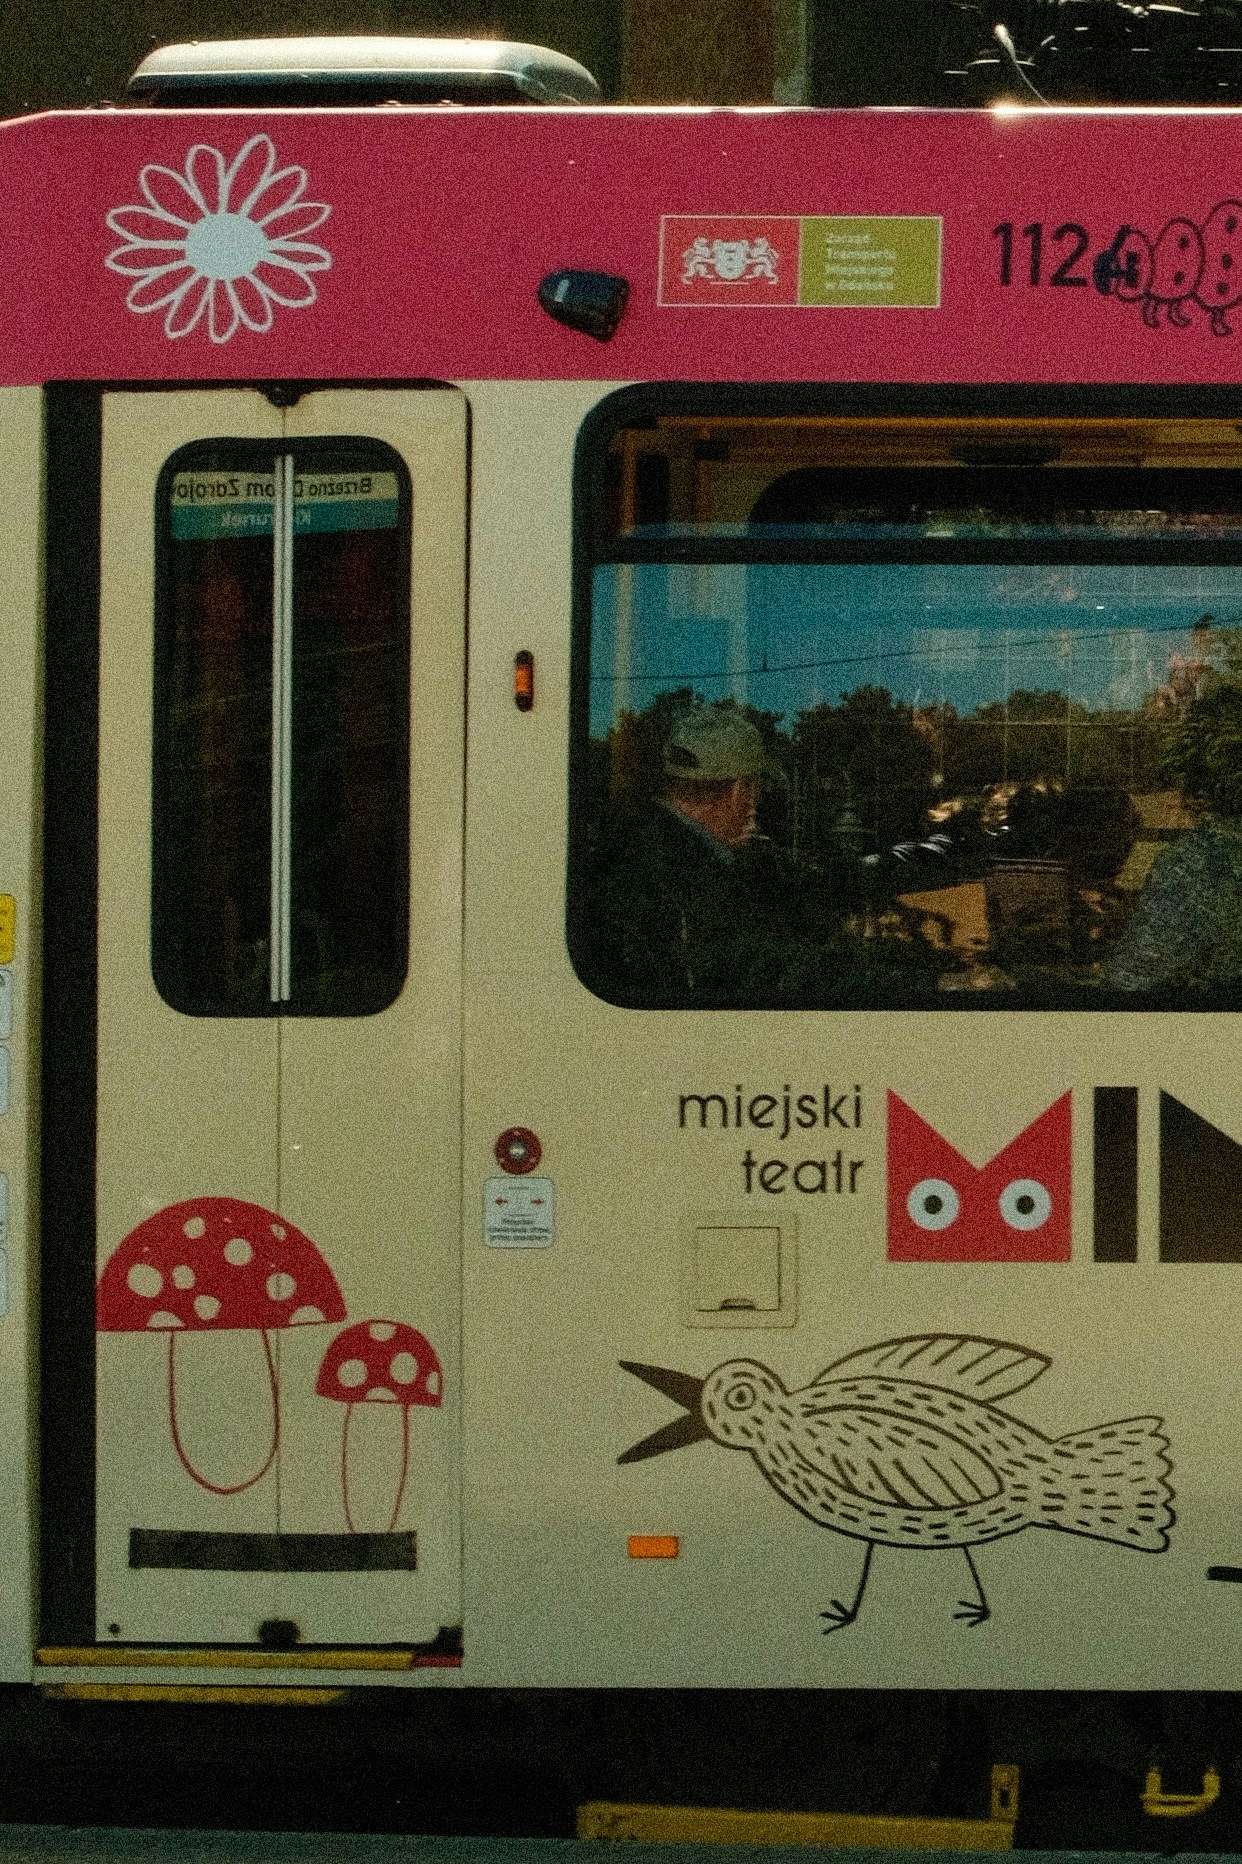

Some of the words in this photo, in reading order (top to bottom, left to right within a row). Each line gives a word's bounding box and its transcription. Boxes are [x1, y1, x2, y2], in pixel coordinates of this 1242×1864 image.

[992, 221, 1141, 288] 1124
[679, 1084, 862, 1140] miejski
[741, 1149, 864, 1194] teatr
